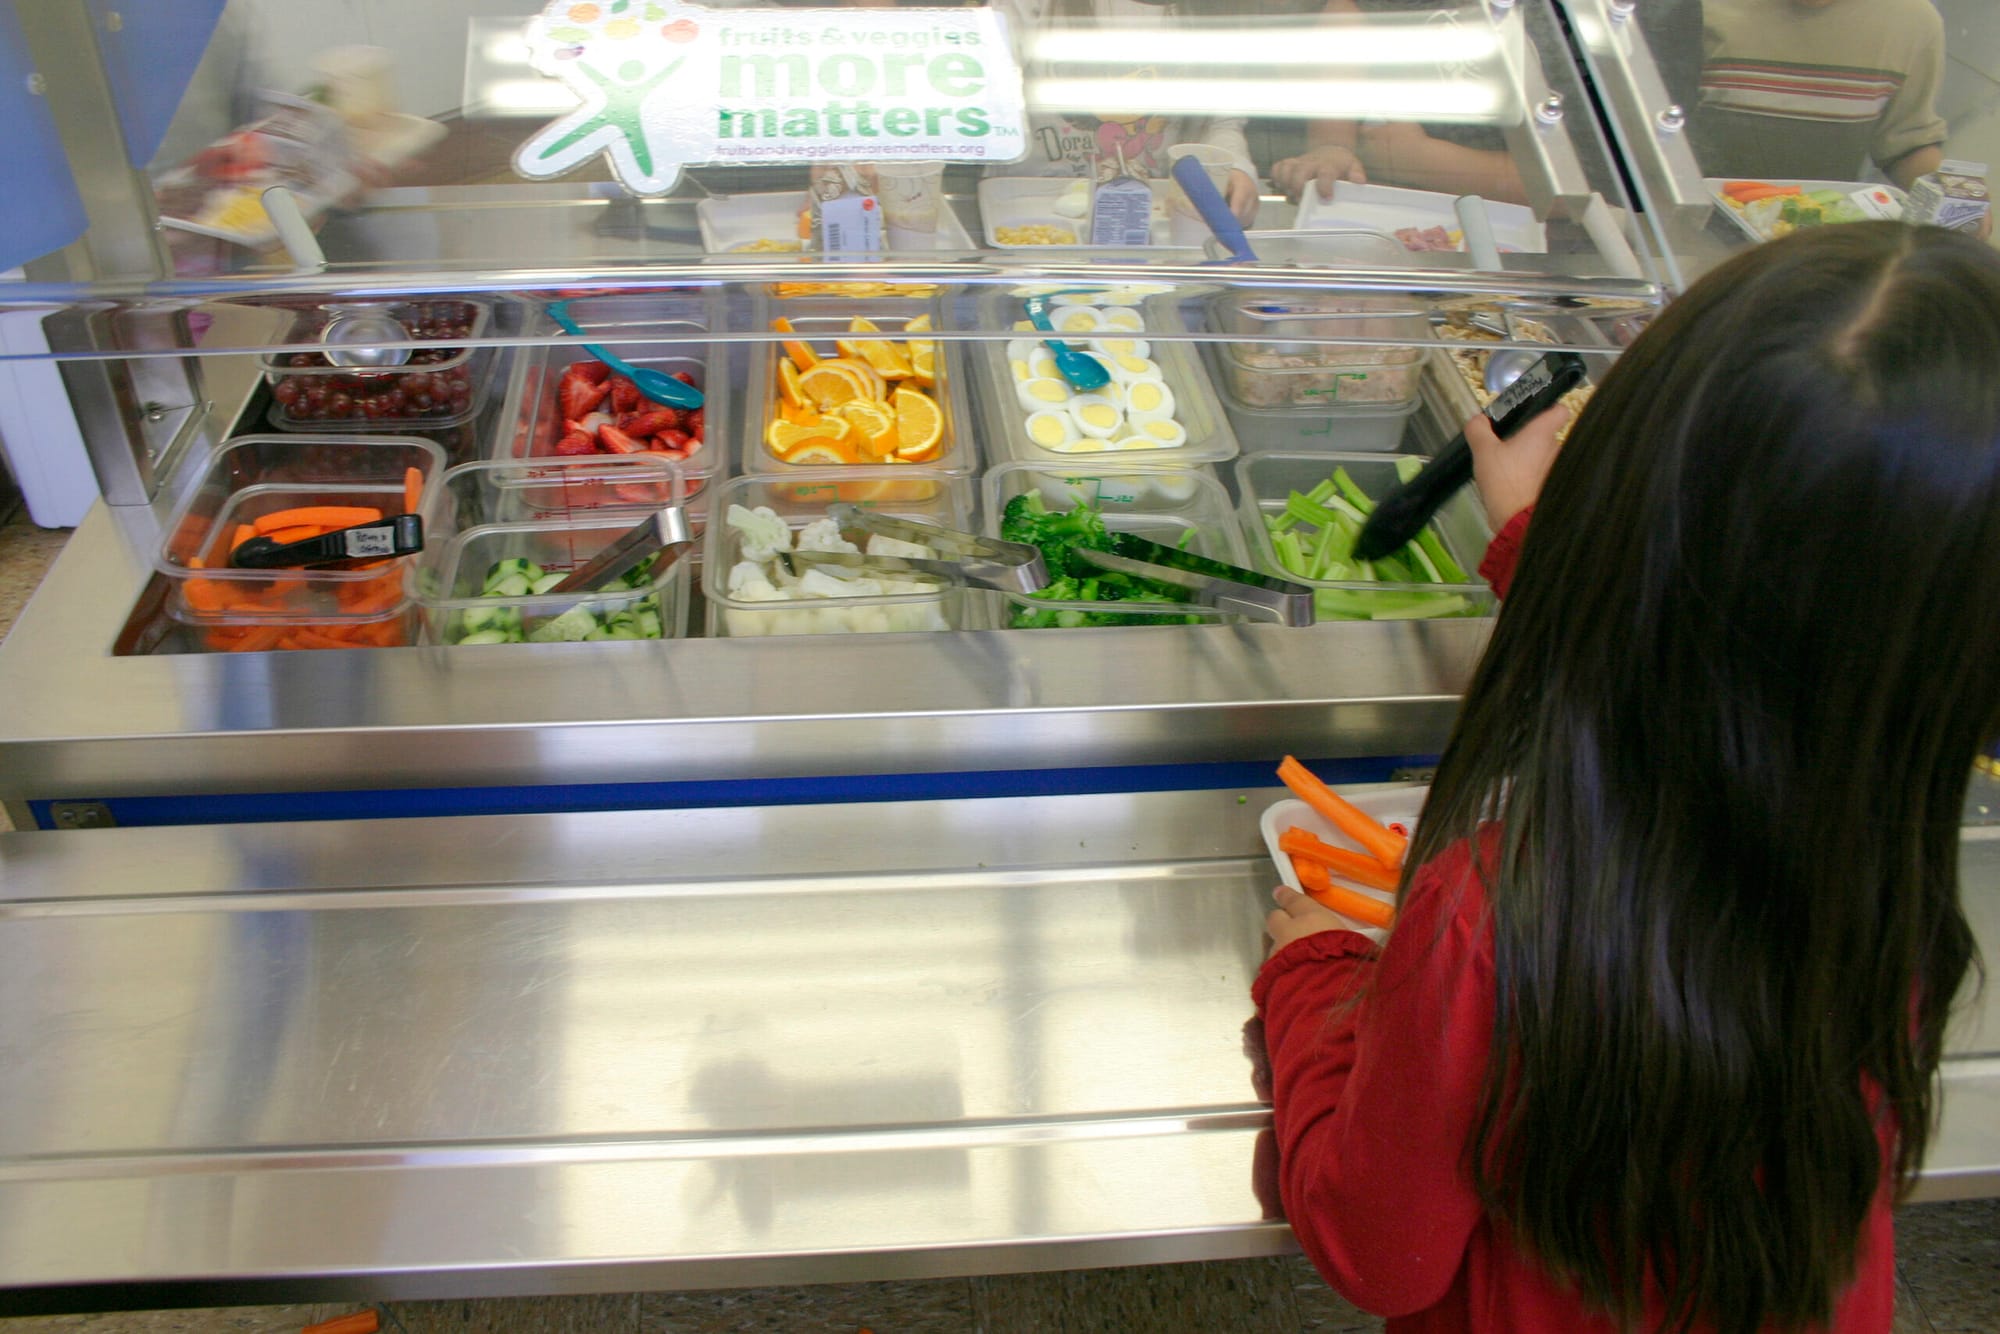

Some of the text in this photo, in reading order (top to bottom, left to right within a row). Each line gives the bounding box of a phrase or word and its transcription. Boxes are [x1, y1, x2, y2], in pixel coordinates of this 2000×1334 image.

[719, 26, 983, 49] fruits & veggies
[719, 52, 987, 98] more
[718, 100, 992, 139] matters
[717, 144, 986, 158] fruitsandveggiesmorematters.org
[1034, 126, 1094, 163] Dora
